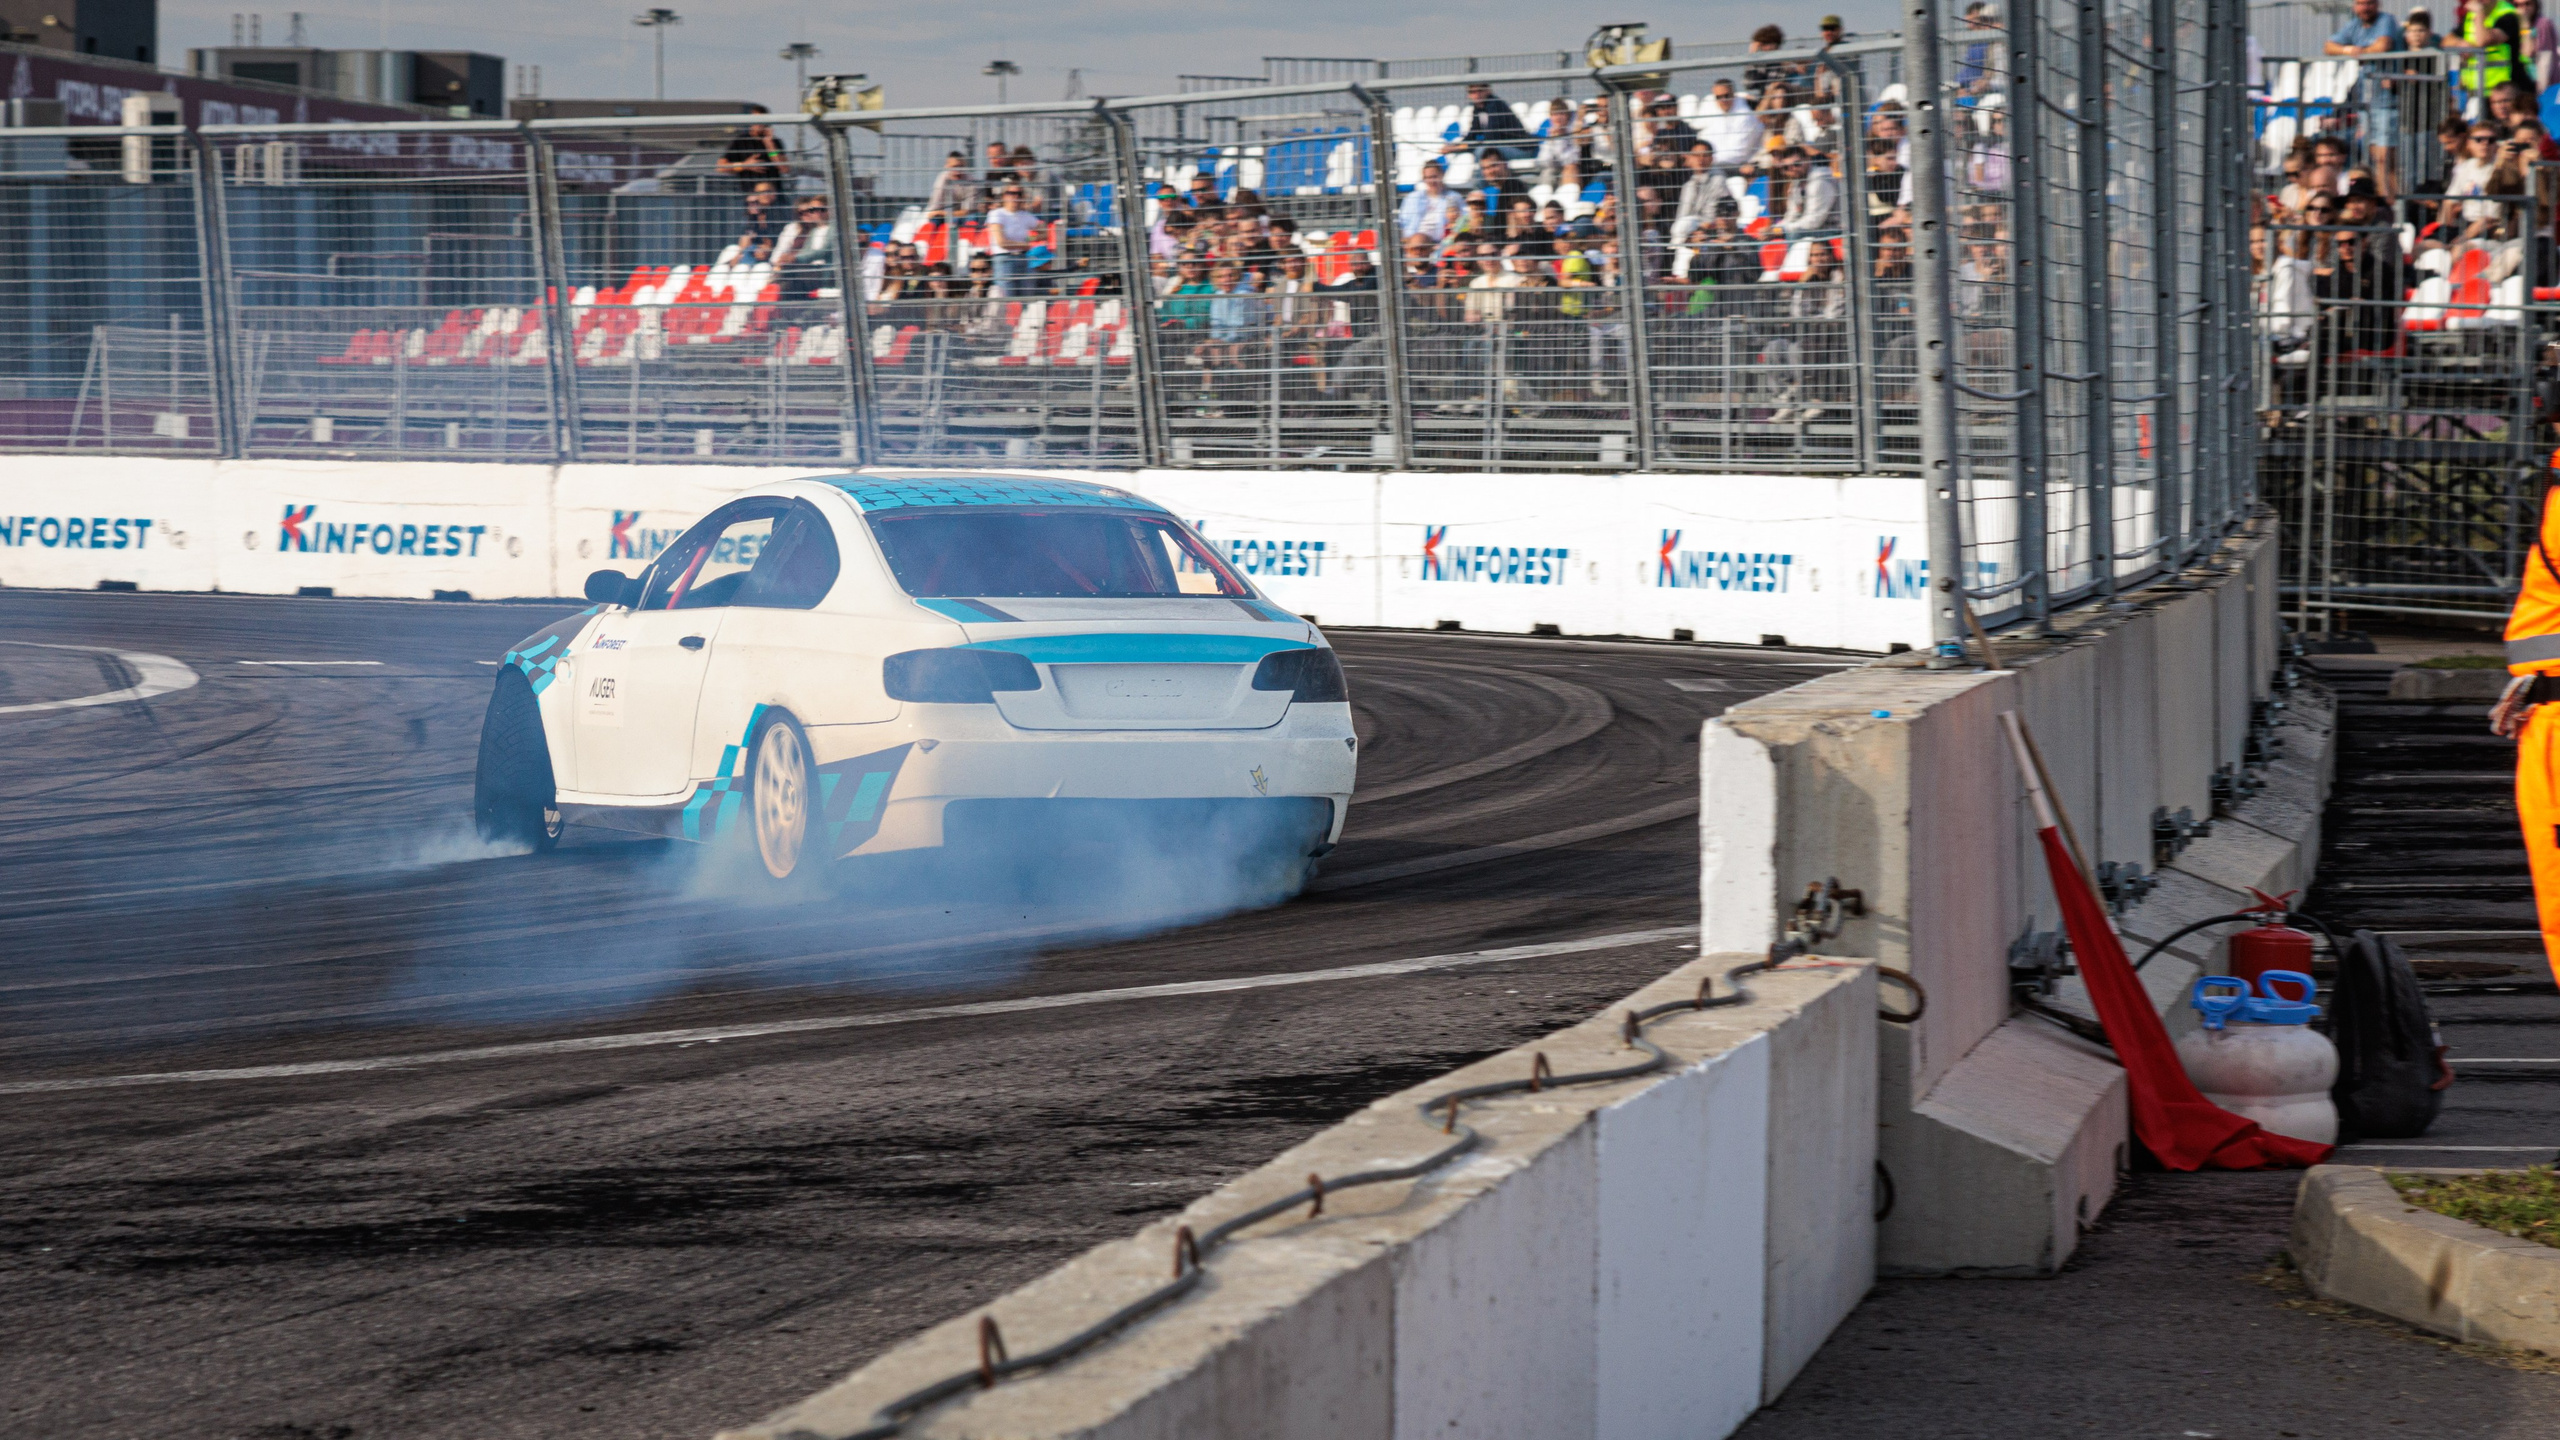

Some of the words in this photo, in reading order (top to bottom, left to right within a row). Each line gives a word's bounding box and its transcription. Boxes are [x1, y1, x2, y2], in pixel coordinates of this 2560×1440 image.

[278, 504, 486, 557] KINFOREST
[1420, 524, 1569, 585] KINFOREST
[1656, 528, 1793, 594] KINFOREST
